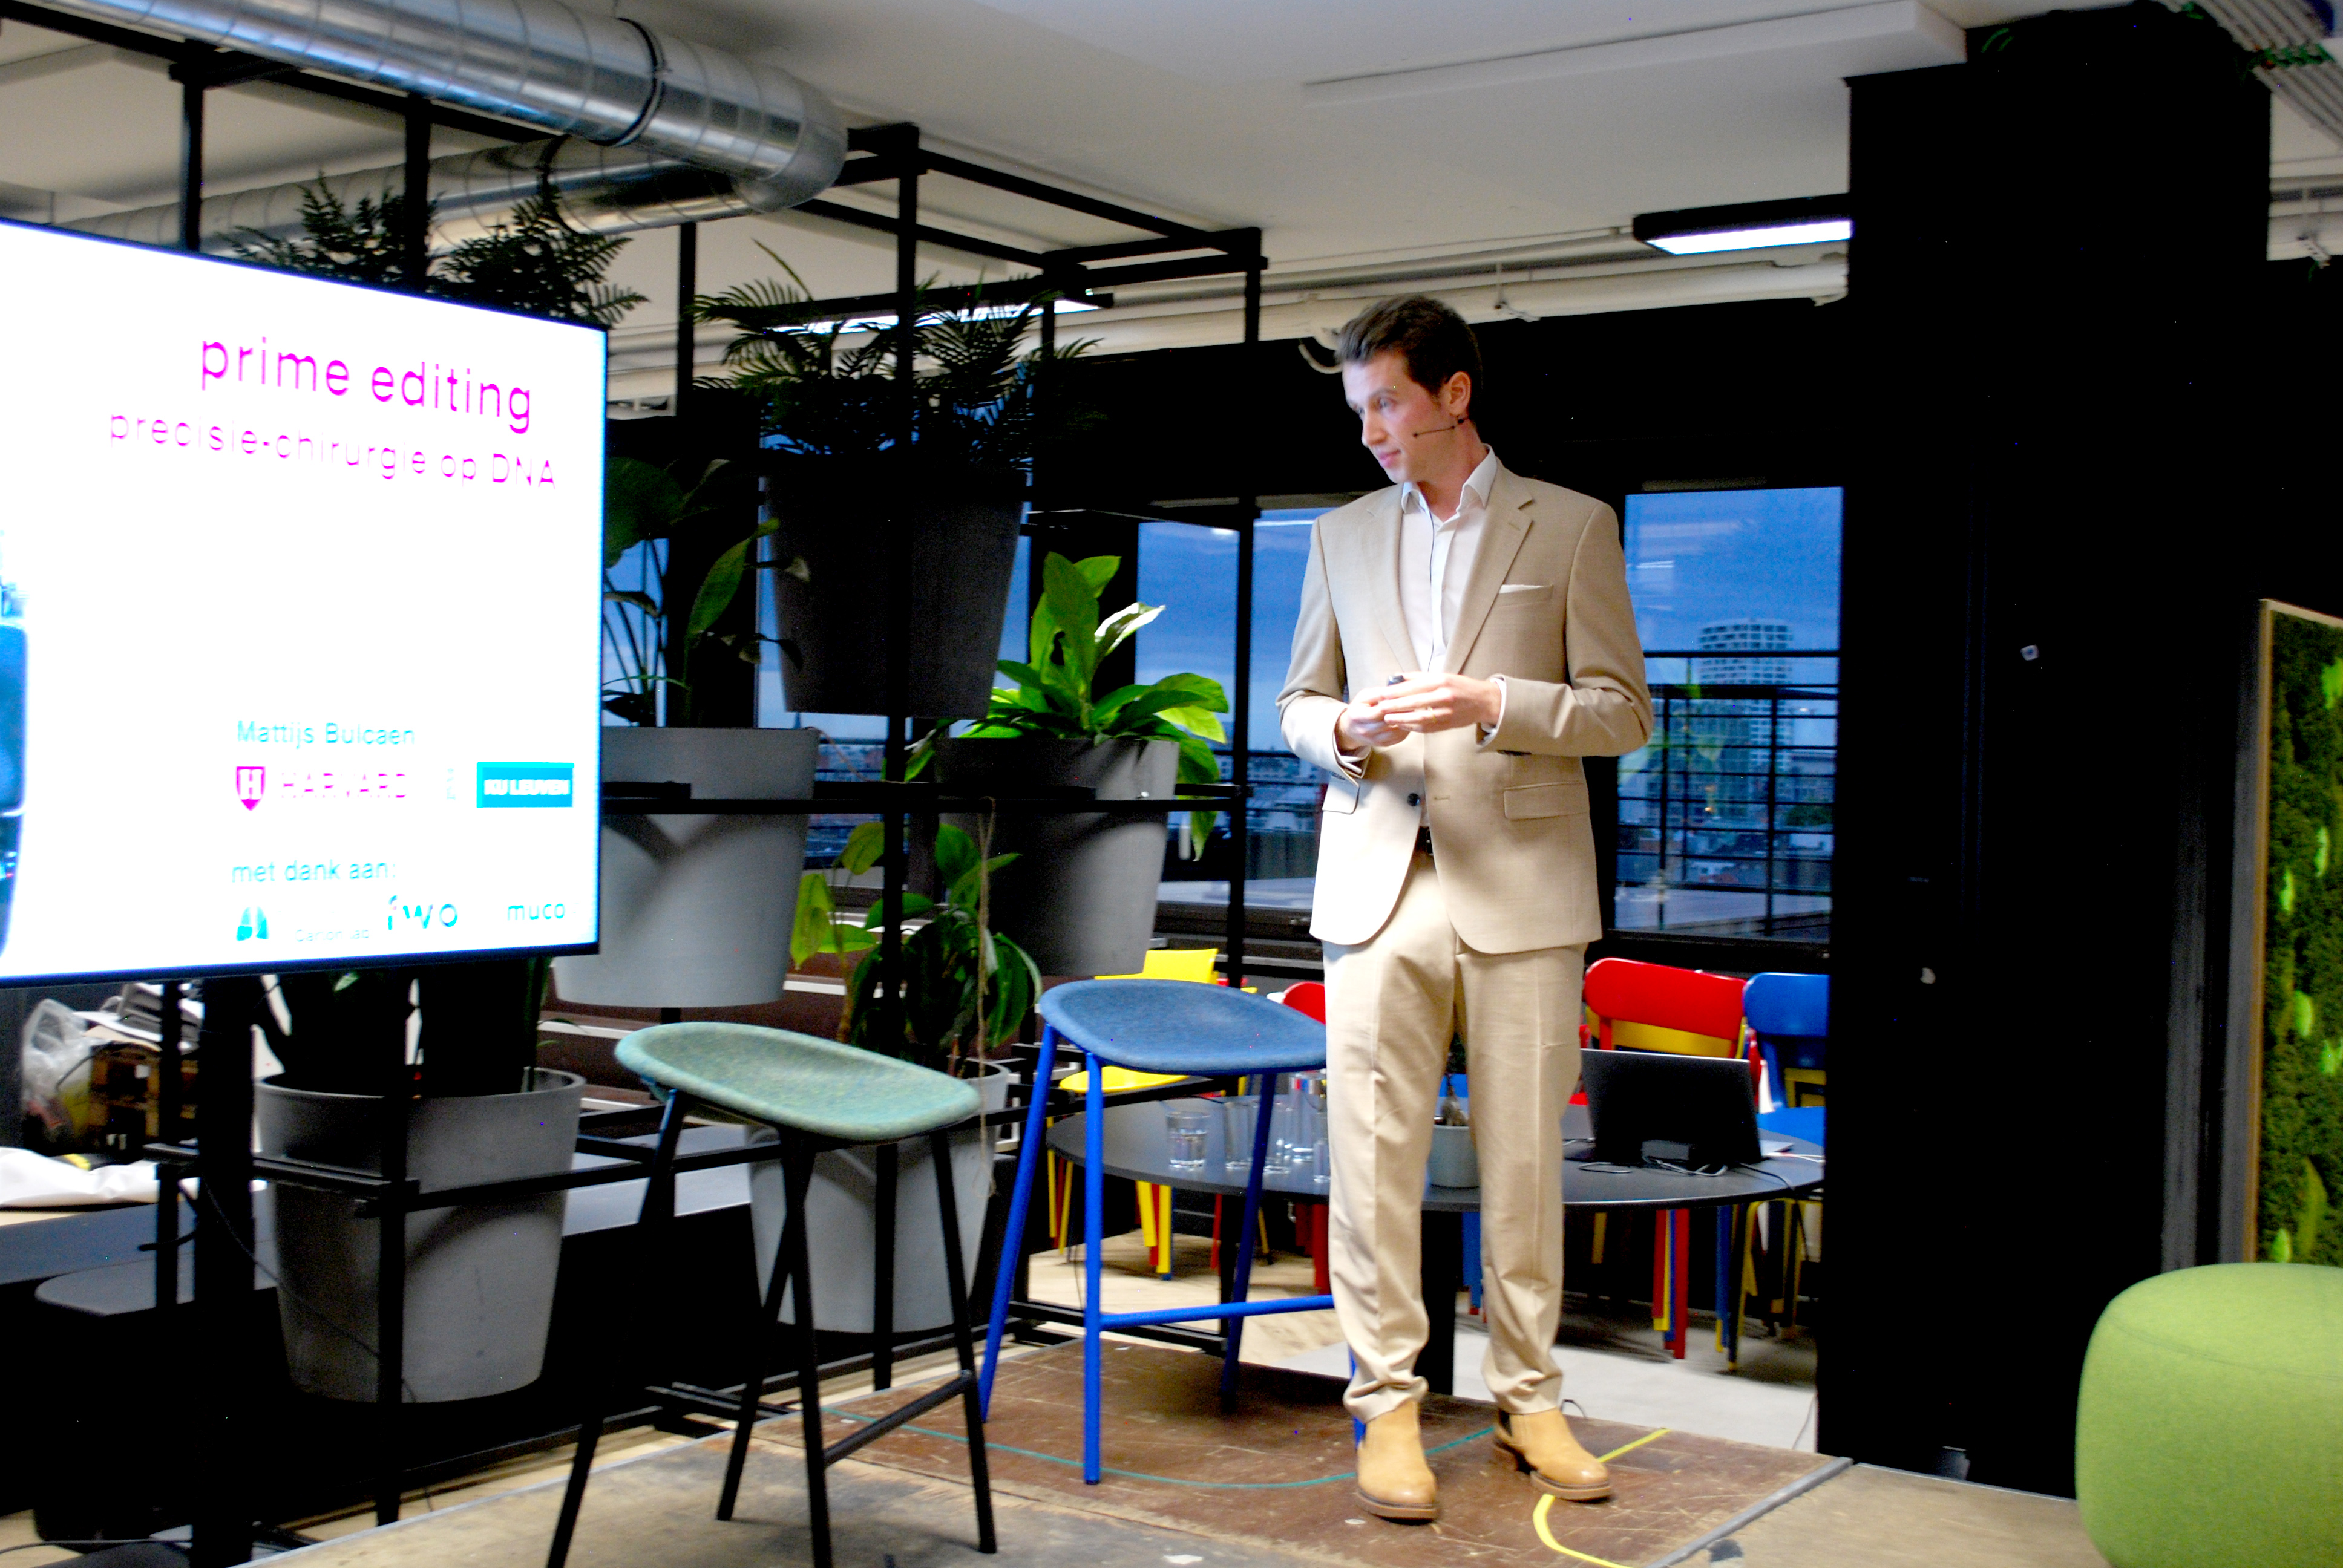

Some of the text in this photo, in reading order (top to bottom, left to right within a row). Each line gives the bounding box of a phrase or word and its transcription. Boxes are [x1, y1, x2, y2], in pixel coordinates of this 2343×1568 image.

[201, 336, 531, 435] prime editing
[110, 414, 556, 489] precisie-chirurgie op DNA
[237, 720, 415, 750] Mattijs Bulcaen
[484, 779, 508, 795] KU
[232, 858, 396, 883] met dank aan:
[507, 903, 566, 921] muco
